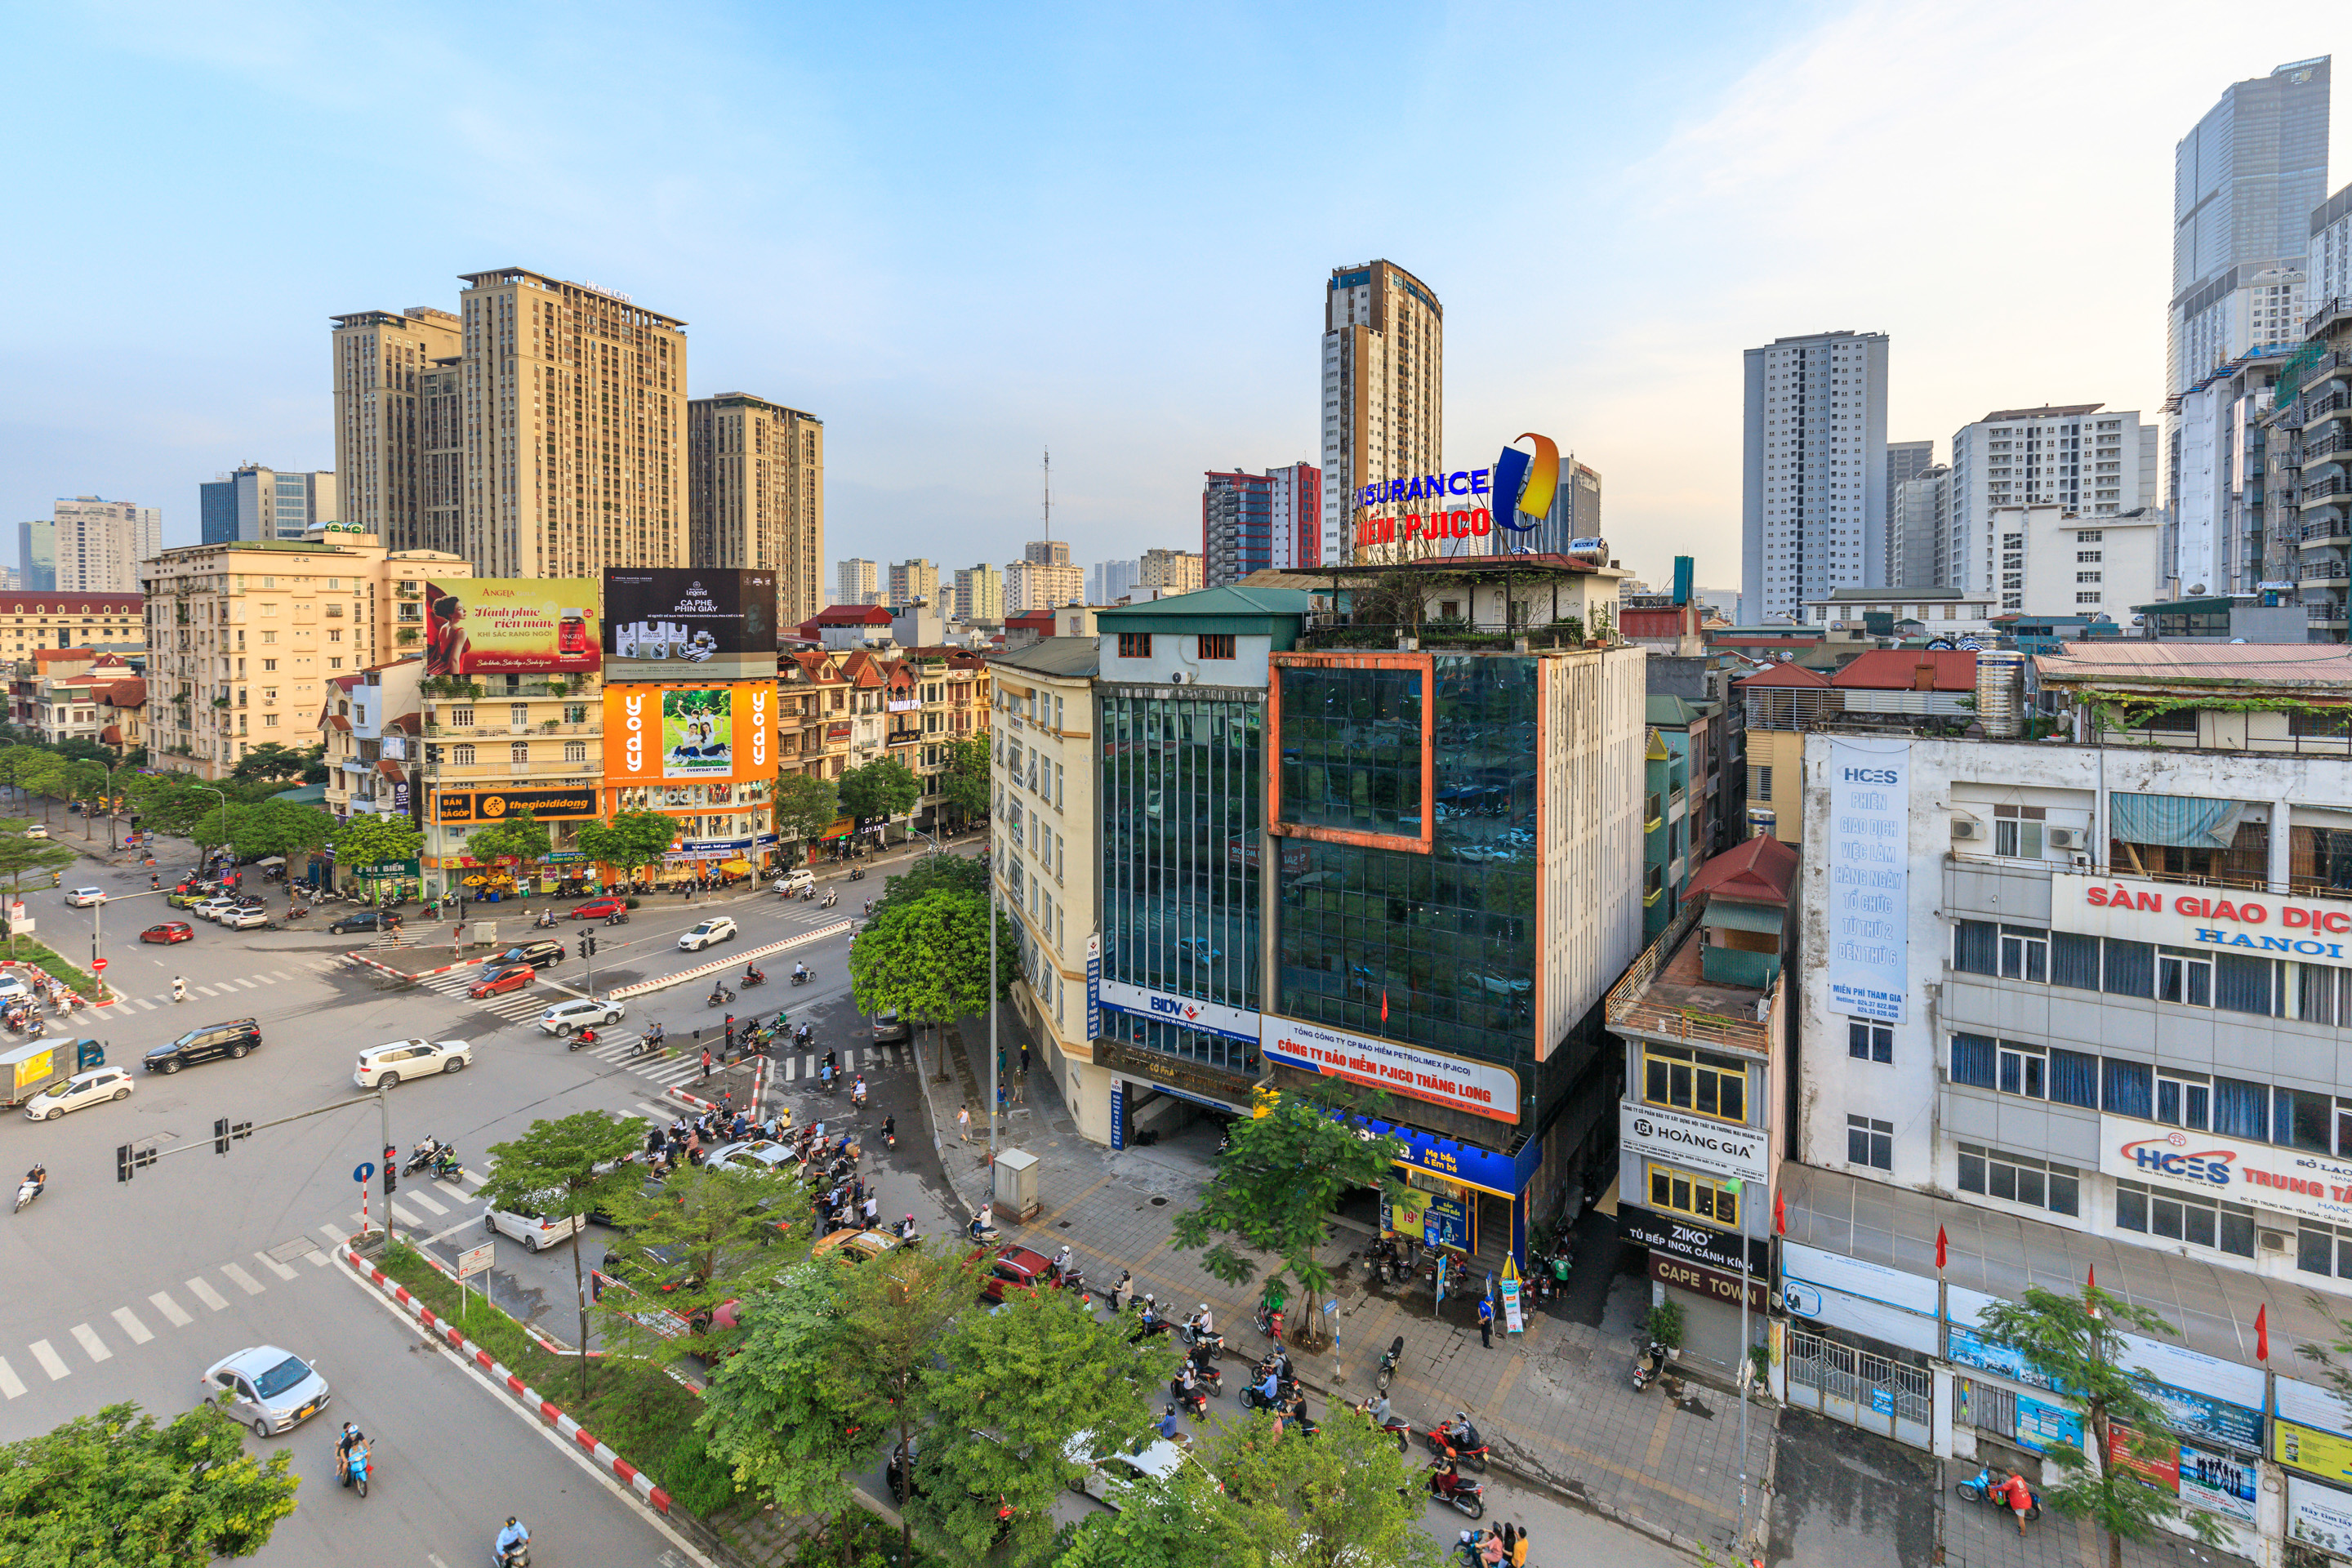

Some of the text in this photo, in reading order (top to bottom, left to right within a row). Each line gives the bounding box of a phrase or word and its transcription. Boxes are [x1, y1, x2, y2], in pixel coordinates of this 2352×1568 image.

[1405, 507, 1491, 541] PJICO
[482, 588, 515, 598] ANGELA
[889, 699, 922, 712] MARIAN SPA
[626, 696, 642, 772] yody
[753, 693, 765, 765] yody
[1844, 767, 1898, 784] HCES
[443, 797, 462, 806] BÁN
[452, 807, 470, 817] GÓP
[509, 799, 588, 811] thegioididong
[1851, 790, 1887, 811] PHIÊN
[1840, 816, 1898, 840] GIAO DỊCH
[1841, 840, 1896, 863] VIỆC LÀM
[1835, 864, 1902, 889] HÀNG NGÀY
[1843, 888, 1893, 914] TỔ CHỨC
[2087, 883, 2352, 936] SÀN GIAO DỊC
[1842, 915, 1893, 940] TỪ THỨ 2
[1088, 950, 1099, 958] BIDV
[1838, 939, 1898, 967] ĐẾN THỨ 6
[2194, 927, 2344, 959] HANOI
[1088, 960, 1099, 969] NGÂN
[1833, 983, 1902, 1003] MIỄN PHÍ THAM GIA
[1151, 996, 1183, 1016] BIDV
[1294, 1026, 1313, 1037] TỔNG
[1314, 1031, 1334, 1043] CÔNG
[1347, 1040, 1357, 1048] CP
[1357, 1041, 1373, 1052] BẢO
[1374, 1045, 1392, 1056] HIỂM
[1393, 1051, 1442, 1069] PETROLIMEX
[1443, 1062, 1471, 1076] (PJICO)
[1277, 1038, 1307, 1058] CÔNG
[1309, 1047, 1323, 1061] TY
[1325, 1049, 1347, 1067] BẢO
[1348, 1054, 1377, 1075] HIỂM
[1379, 1064, 1414, 1084] PJICO
[1415, 1073, 1456, 1094] THĂNG
[1459, 1083, 1492, 1103] LONG
[1364, 1079, 1378, 1087] TRUNG
[1410, 1089, 1419, 1097] YÊN
[1431, 1095, 1444, 1103] QUẬN
[1445, 1098, 1454, 1106] CẦU
[1679, 1116, 1690, 1125] DỰNG
[1716, 1125, 1732, 1134] THƯƠNG
[1742, 1131, 1756, 1140] HOÀNG
[1658, 1126, 1752, 1159] HOÀNG GIA
[1423, 1156, 1458, 1173] & Em bé
[1425, 1148, 1456, 1165] Mẹ bầu
[2137, 1147, 2230, 1185] HCES
[2296, 1158, 2318, 1169] SỞ
[2242, 1167, 2325, 1198] TRUNG
[2260, 1200, 2278, 1209] TRUNG
[2337, 1216, 2350, 1224] GIẤY
[1671, 1224, 1708, 1246] ZIKO
[1629, 1228, 1643, 1240] TỦ
[1646, 1231, 1666, 1245] BẾP
[1668, 1240, 1692, 1254] INOX
[1695, 1247, 1725, 1263] CÁNH
[1726, 1256, 1753, 1272] KÍNH
[1658, 1263, 1701, 1288] CAPE
[1709, 1277, 1757, 1305] TOWN
[2301, 1505, 2337, 1522] Hãy tìm
